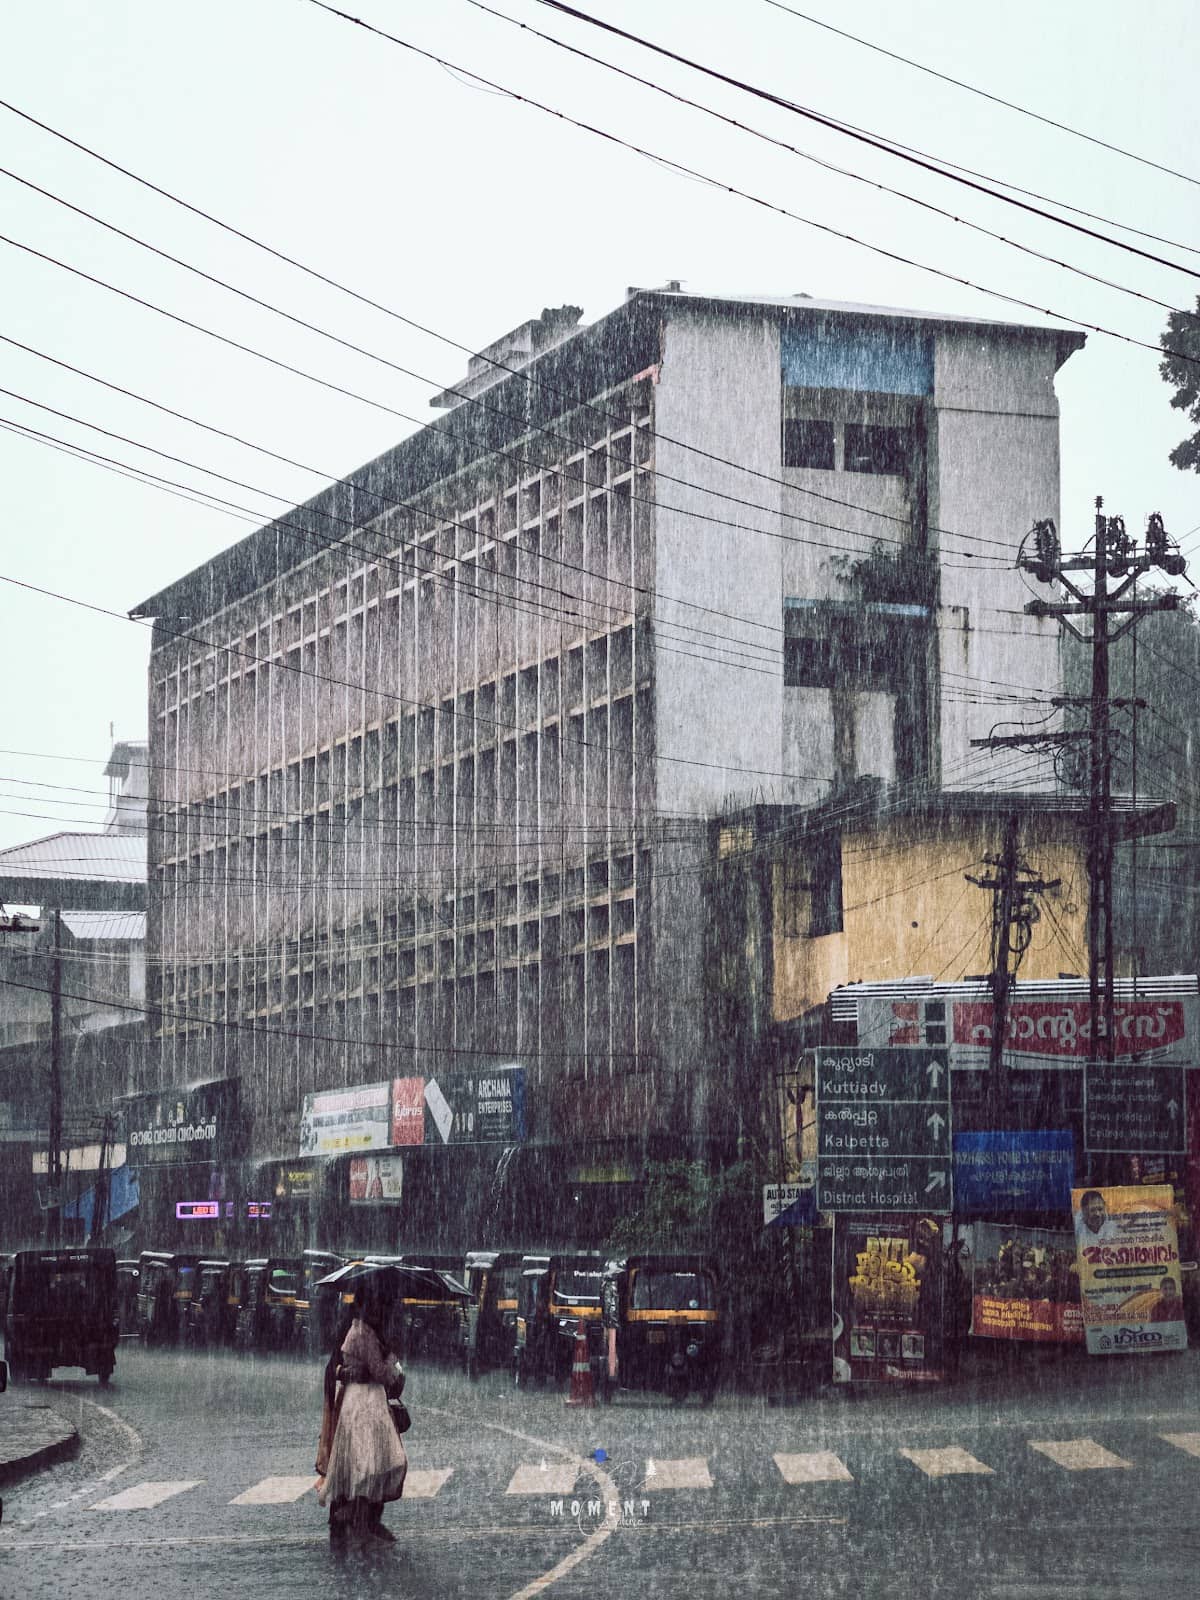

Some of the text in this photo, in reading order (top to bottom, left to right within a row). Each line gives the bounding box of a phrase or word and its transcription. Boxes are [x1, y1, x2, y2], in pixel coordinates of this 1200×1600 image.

[479, 1078, 512, 1098] ARCHANA
[823, 1081, 887, 1096] Kuttiady
[478, 1100, 513, 1114] ENTERPRISES
[825, 1134, 890, 1149] Kalpetta
[766, 1188, 786, 1201] AUTO
[823, 1190, 918, 1206] District Hospital
